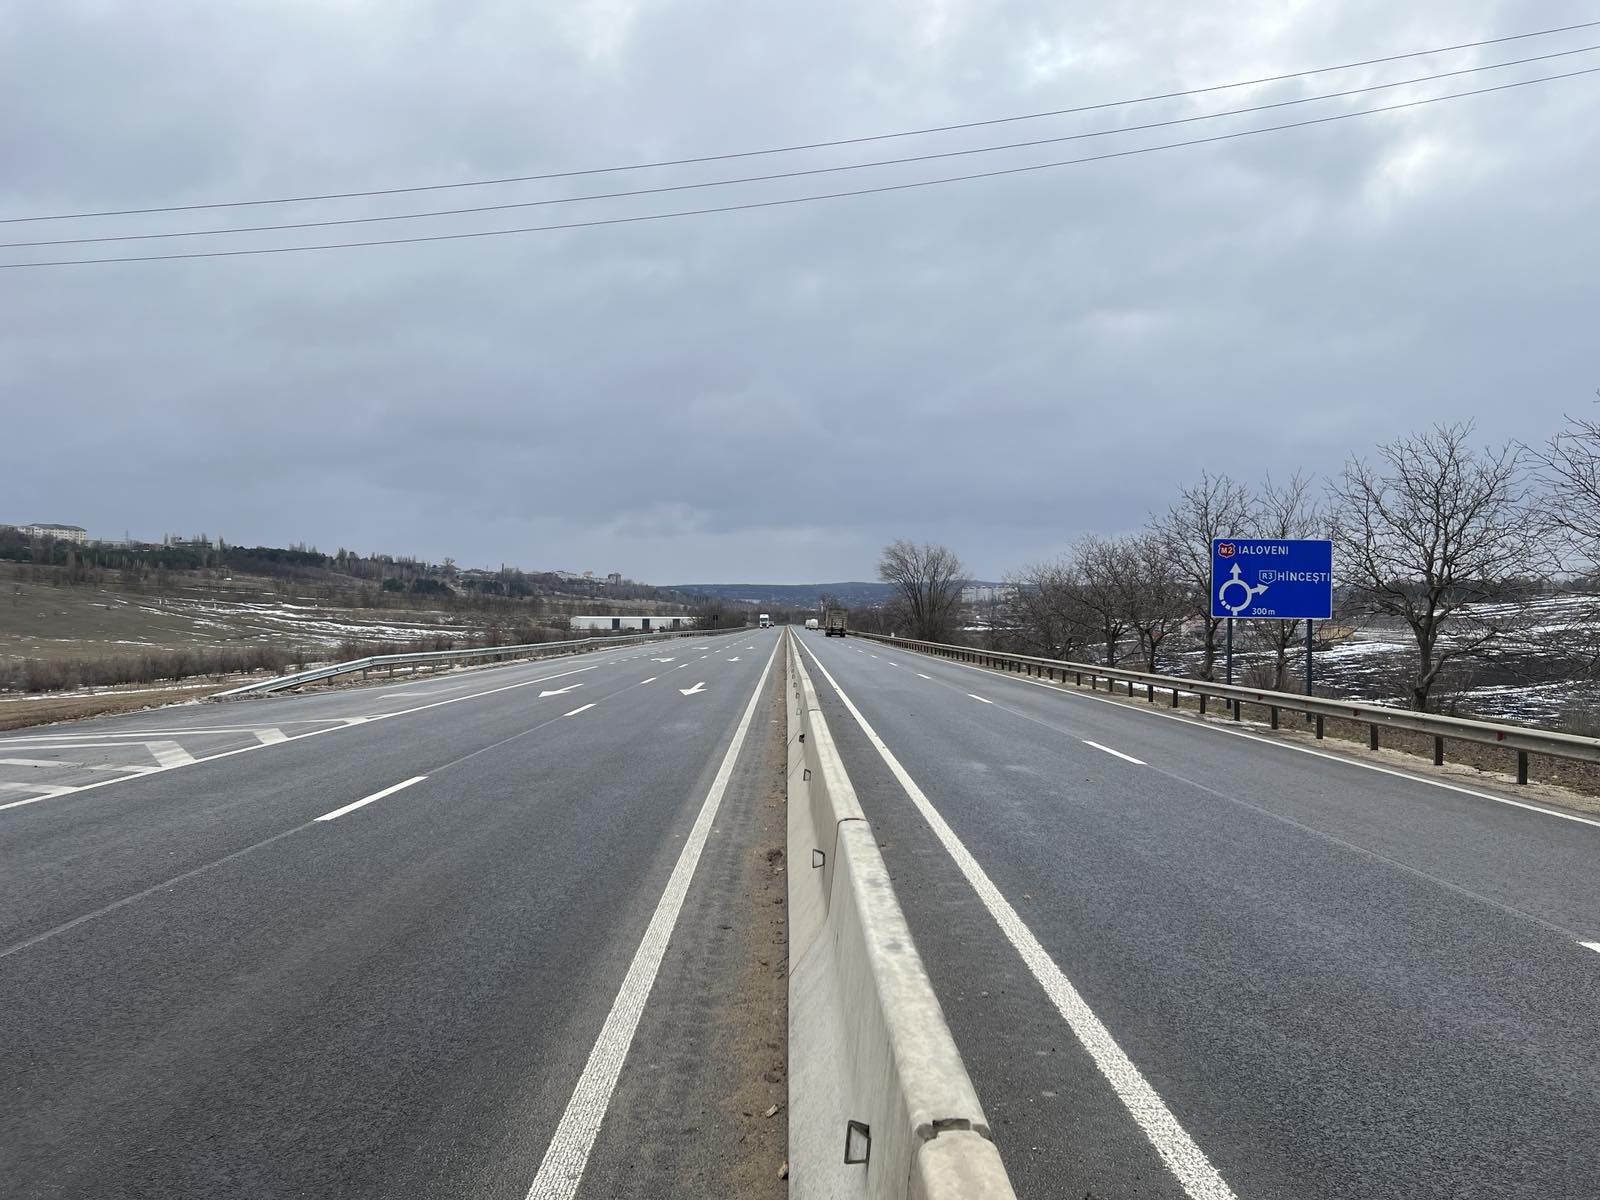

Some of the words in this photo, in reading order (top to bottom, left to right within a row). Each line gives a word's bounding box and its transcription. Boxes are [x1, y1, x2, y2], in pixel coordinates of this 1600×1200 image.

[1220, 547, 1233, 555] M2
[1238, 545, 1289, 555] IALOVENI
[1262, 572, 1273, 580] R3
[1252, 607, 1267, 615] 300
